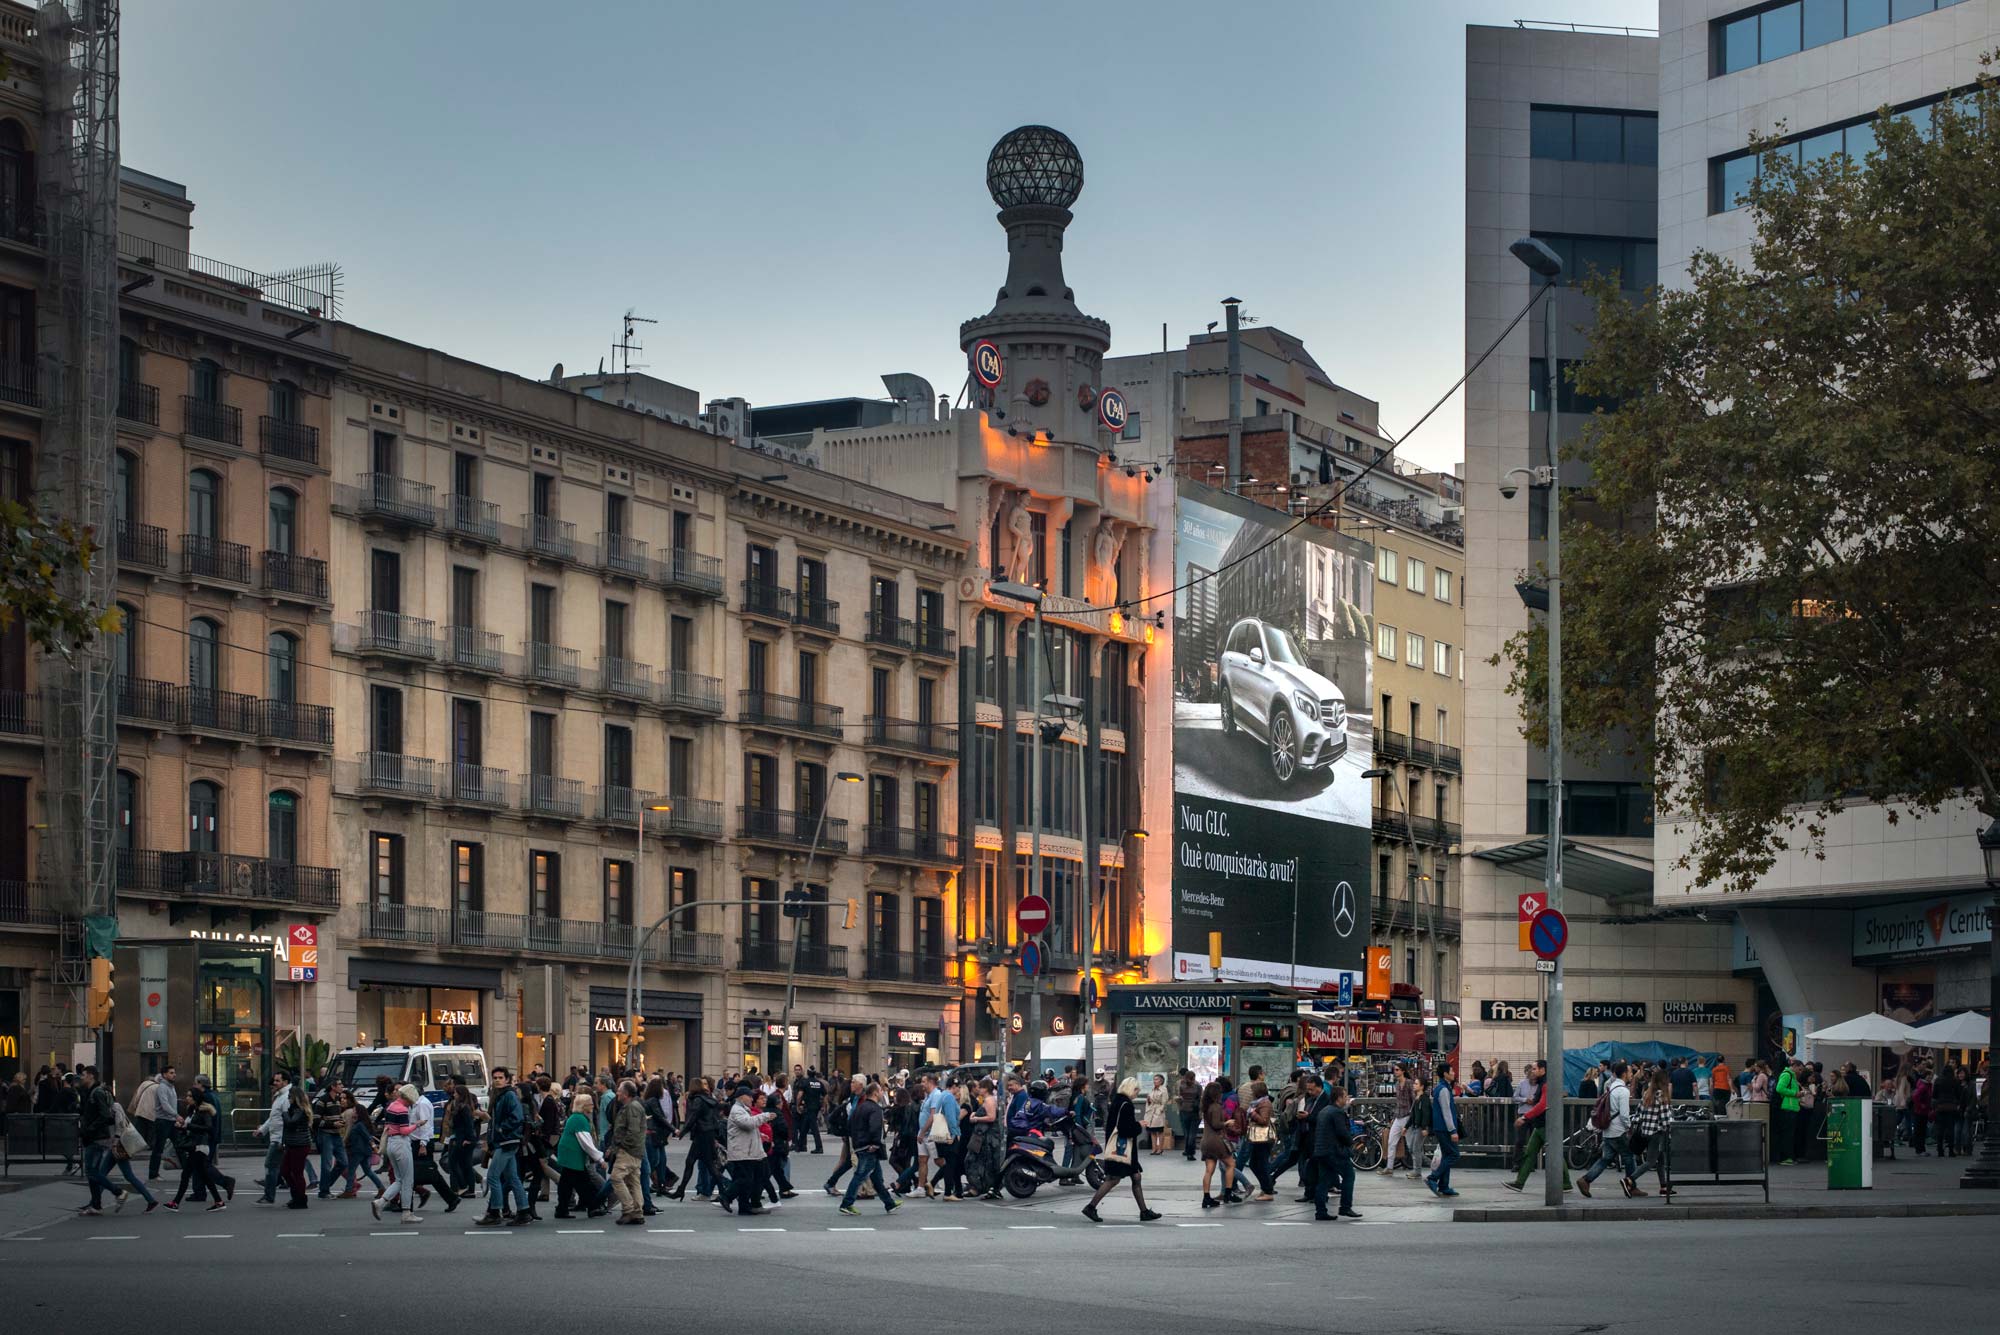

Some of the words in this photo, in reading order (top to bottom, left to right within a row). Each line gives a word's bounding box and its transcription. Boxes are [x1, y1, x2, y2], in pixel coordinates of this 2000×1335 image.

[981, 350, 1000, 377] C&A
[1106, 397, 1125, 421] C&A
[1180, 804, 1202, 833] Nou
[1205, 809, 1230, 838] GLC.
[1181, 841, 1202, 869] Què
[1204, 851, 1268, 880] conquistaràs
[1269, 859, 1294, 883] avui?
[1181, 888, 1225, 907] Mercedes-Benz
[1866, 917, 1925, 950] Shopping
[1948, 905, 1992, 935] Centre
[1342, 975, 1350, 989] P
[1151, 995, 1236, 1008] VANGUARDI
[1573, 1006, 1645, 1017] SEPHORA
[1664, 1001, 1704, 1012] URBAN
[440, 1009, 474, 1025] ZARA
[595, 1017, 625, 1032] ZARA
[1664, 1013, 1735, 1024] OUTFITTERS
[1311, 1025, 1356, 1043] BARCELOA
